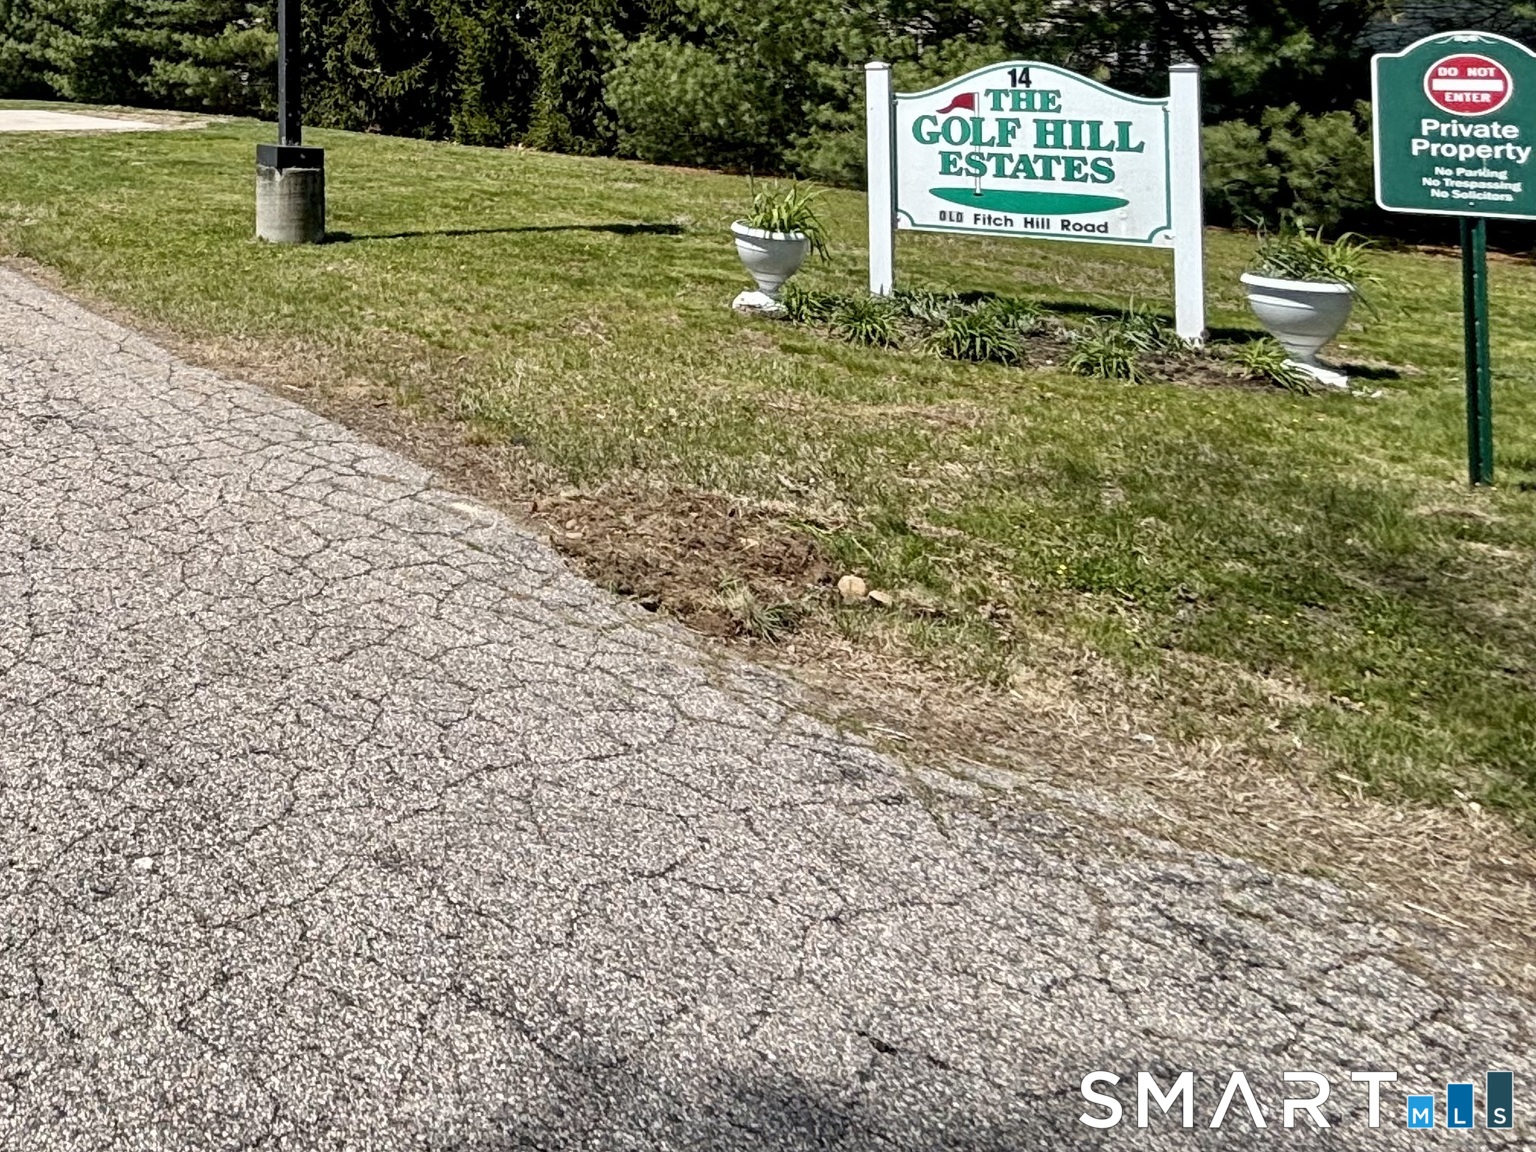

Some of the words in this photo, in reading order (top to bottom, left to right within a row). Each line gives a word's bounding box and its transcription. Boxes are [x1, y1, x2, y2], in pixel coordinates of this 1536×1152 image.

[1007, 67, 1032, 89] 14
[1437, 66, 1459, 77] DO
[1467, 66, 1496, 77] NOT
[984, 88, 1062, 113] THE
[1444, 91, 1492, 103] ENTER
[911, 114, 1021, 148] GOLF
[1033, 118, 1146, 154] HILL
[1420, 118, 1520, 139] Private
[1410, 138, 1532, 164] Property
[938, 150, 1116, 184] ESTATES
[1434, 166, 1454, 176] No
[1455, 167, 1509, 181] Parking
[1421, 177, 1442, 187] No
[1443, 178, 1523, 193] Trespassing
[1430, 188, 1450, 198] No
[1451, 189, 1515, 202] Solicitors
[973, 213, 1015, 228] Fitch
[1023, 217, 1051, 230] Hill
[1060, 219, 1110, 234] Road
